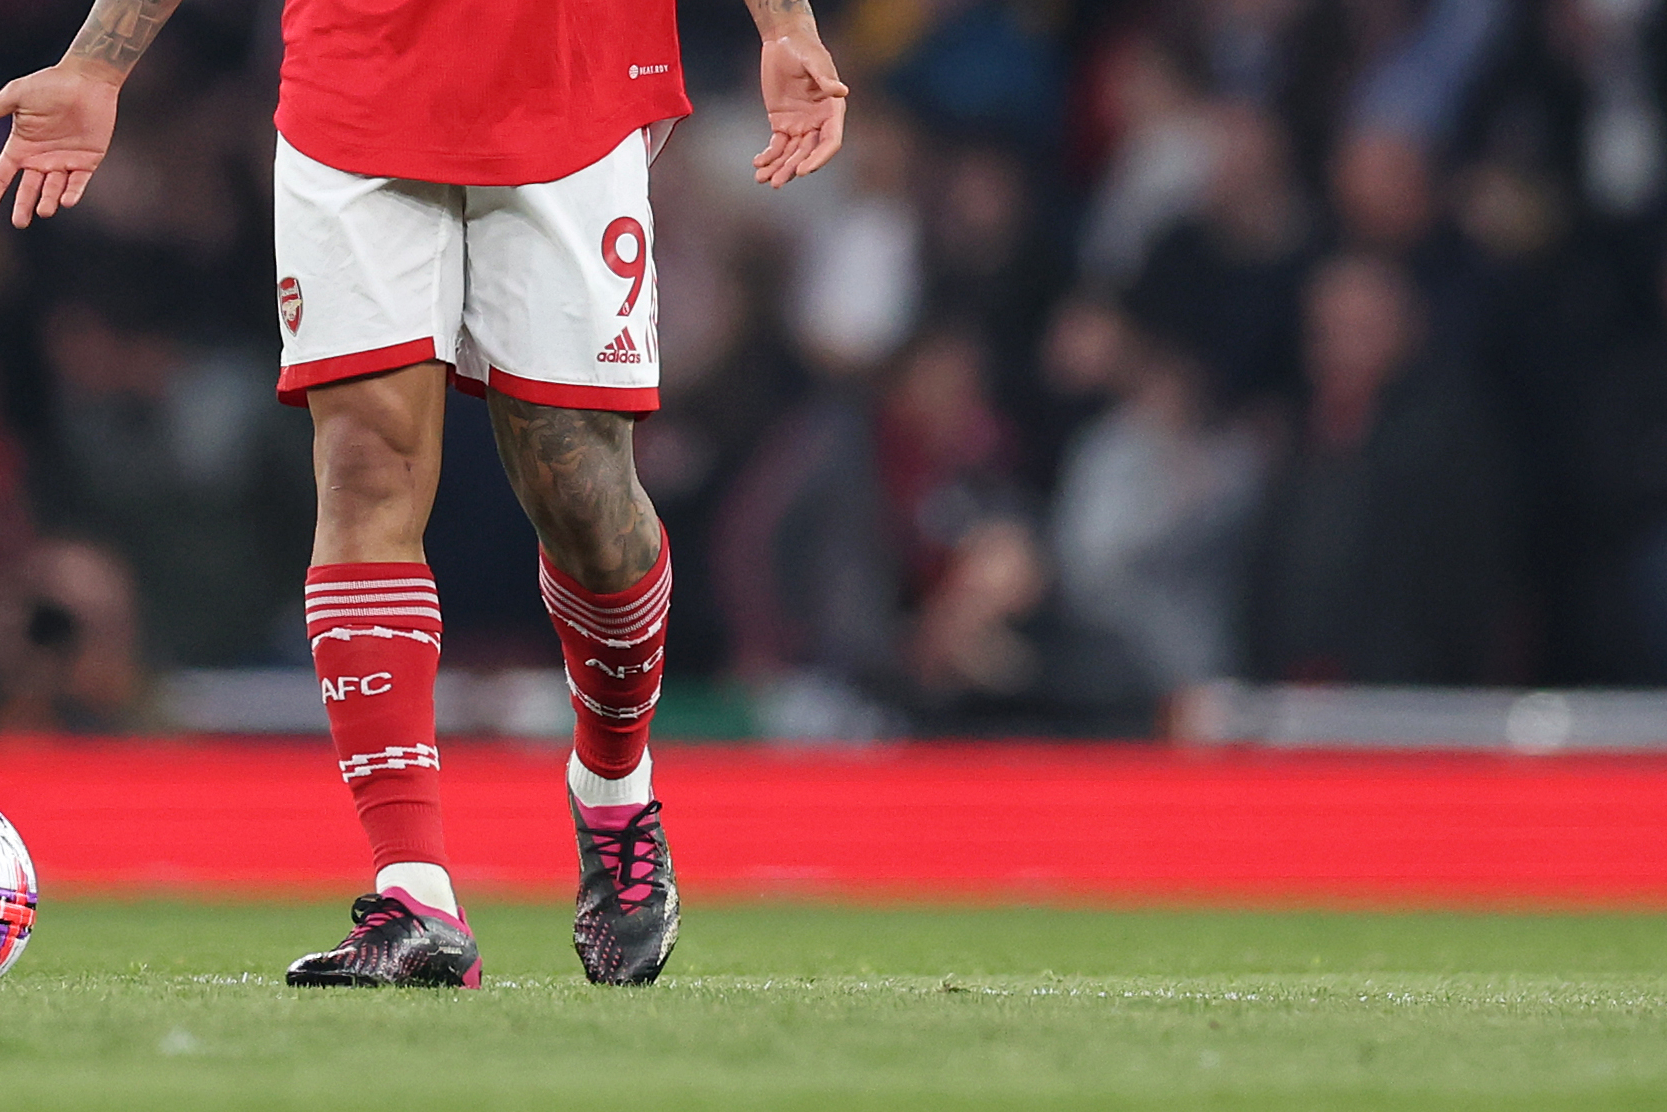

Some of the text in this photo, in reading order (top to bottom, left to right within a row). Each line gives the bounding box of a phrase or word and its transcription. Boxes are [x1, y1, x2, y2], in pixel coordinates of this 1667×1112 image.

[601, 216, 646, 317] 9
[596, 347, 641, 364] adidas
[321, 671, 393, 705] AFC
